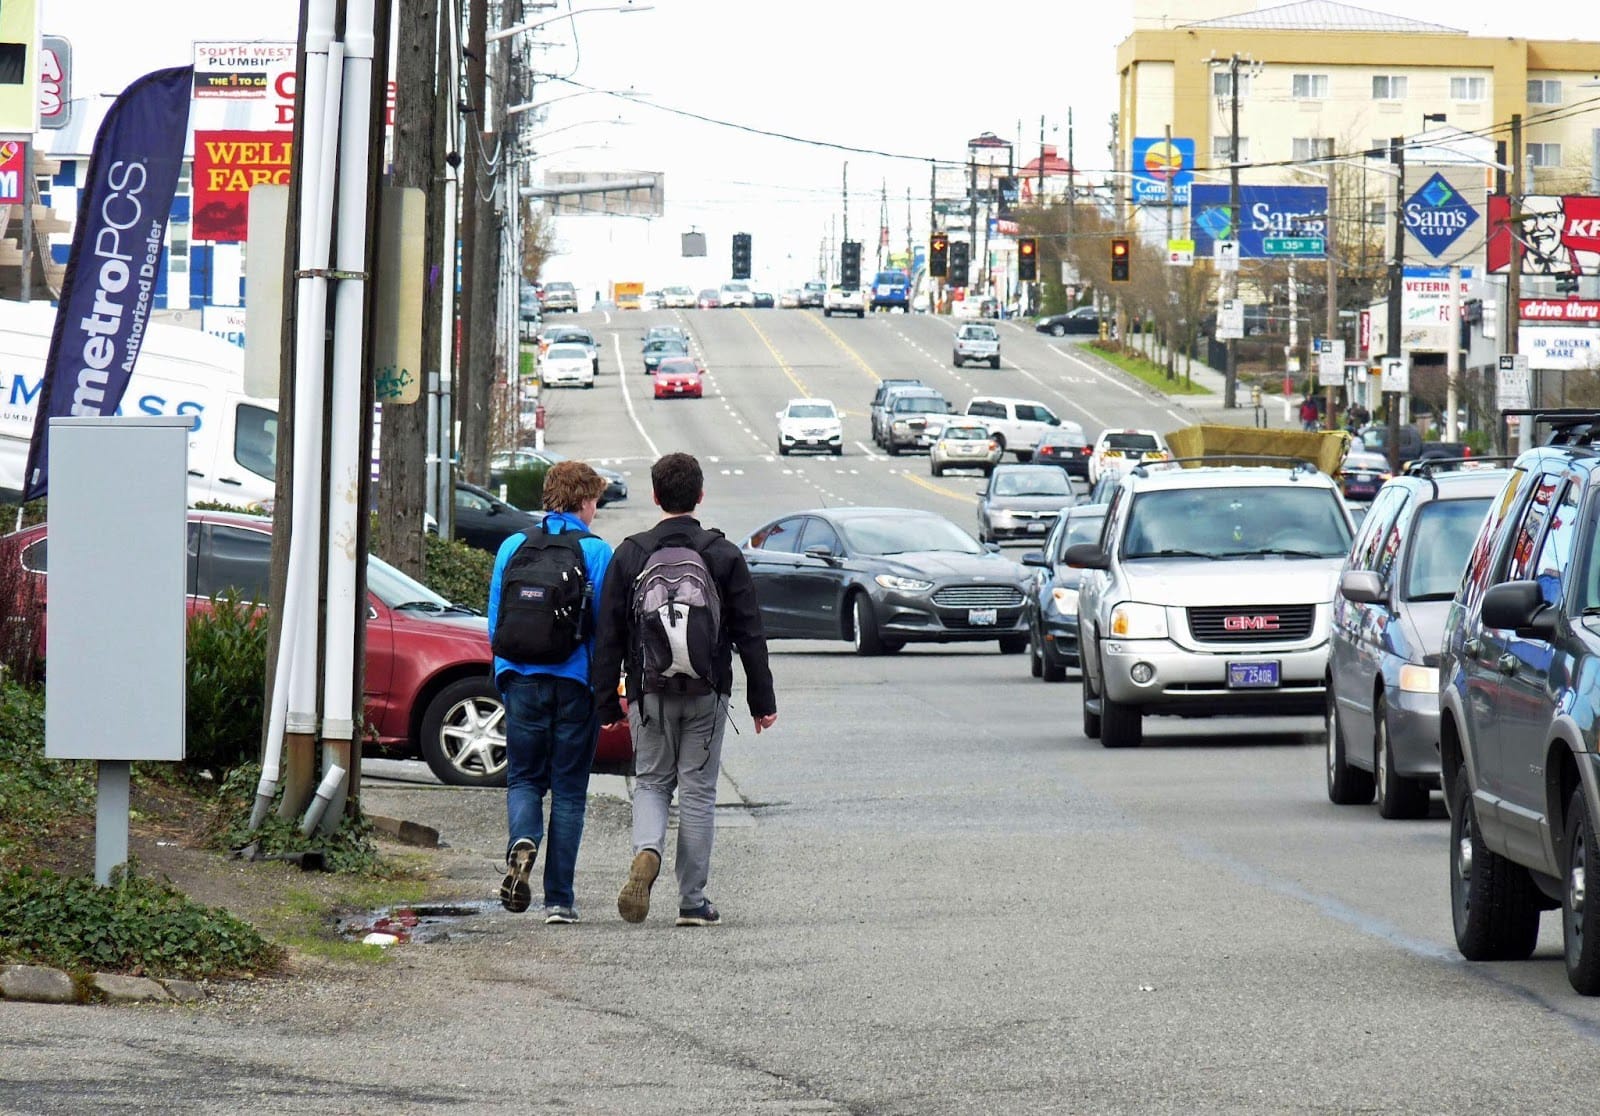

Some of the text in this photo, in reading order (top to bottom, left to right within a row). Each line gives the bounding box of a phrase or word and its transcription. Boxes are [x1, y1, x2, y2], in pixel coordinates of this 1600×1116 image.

[199, 47, 294, 56] SOUTH WEST
[208, 77, 229, 86] THE
[239, 77, 253, 86] TO
[1404, 203, 1468, 228] Sam's
[1420, 227, 1453, 236] CLUB
[70, 158, 147, 417] metroPCS
[121, 219, 163, 373] Authorized Dealer
[1524, 302, 1599, 318] drive thru
[1553, 339, 1591, 349] CHICKEN
[1545, 349, 1575, 359] SHARE
[1223, 614, 1280, 630] GMC
